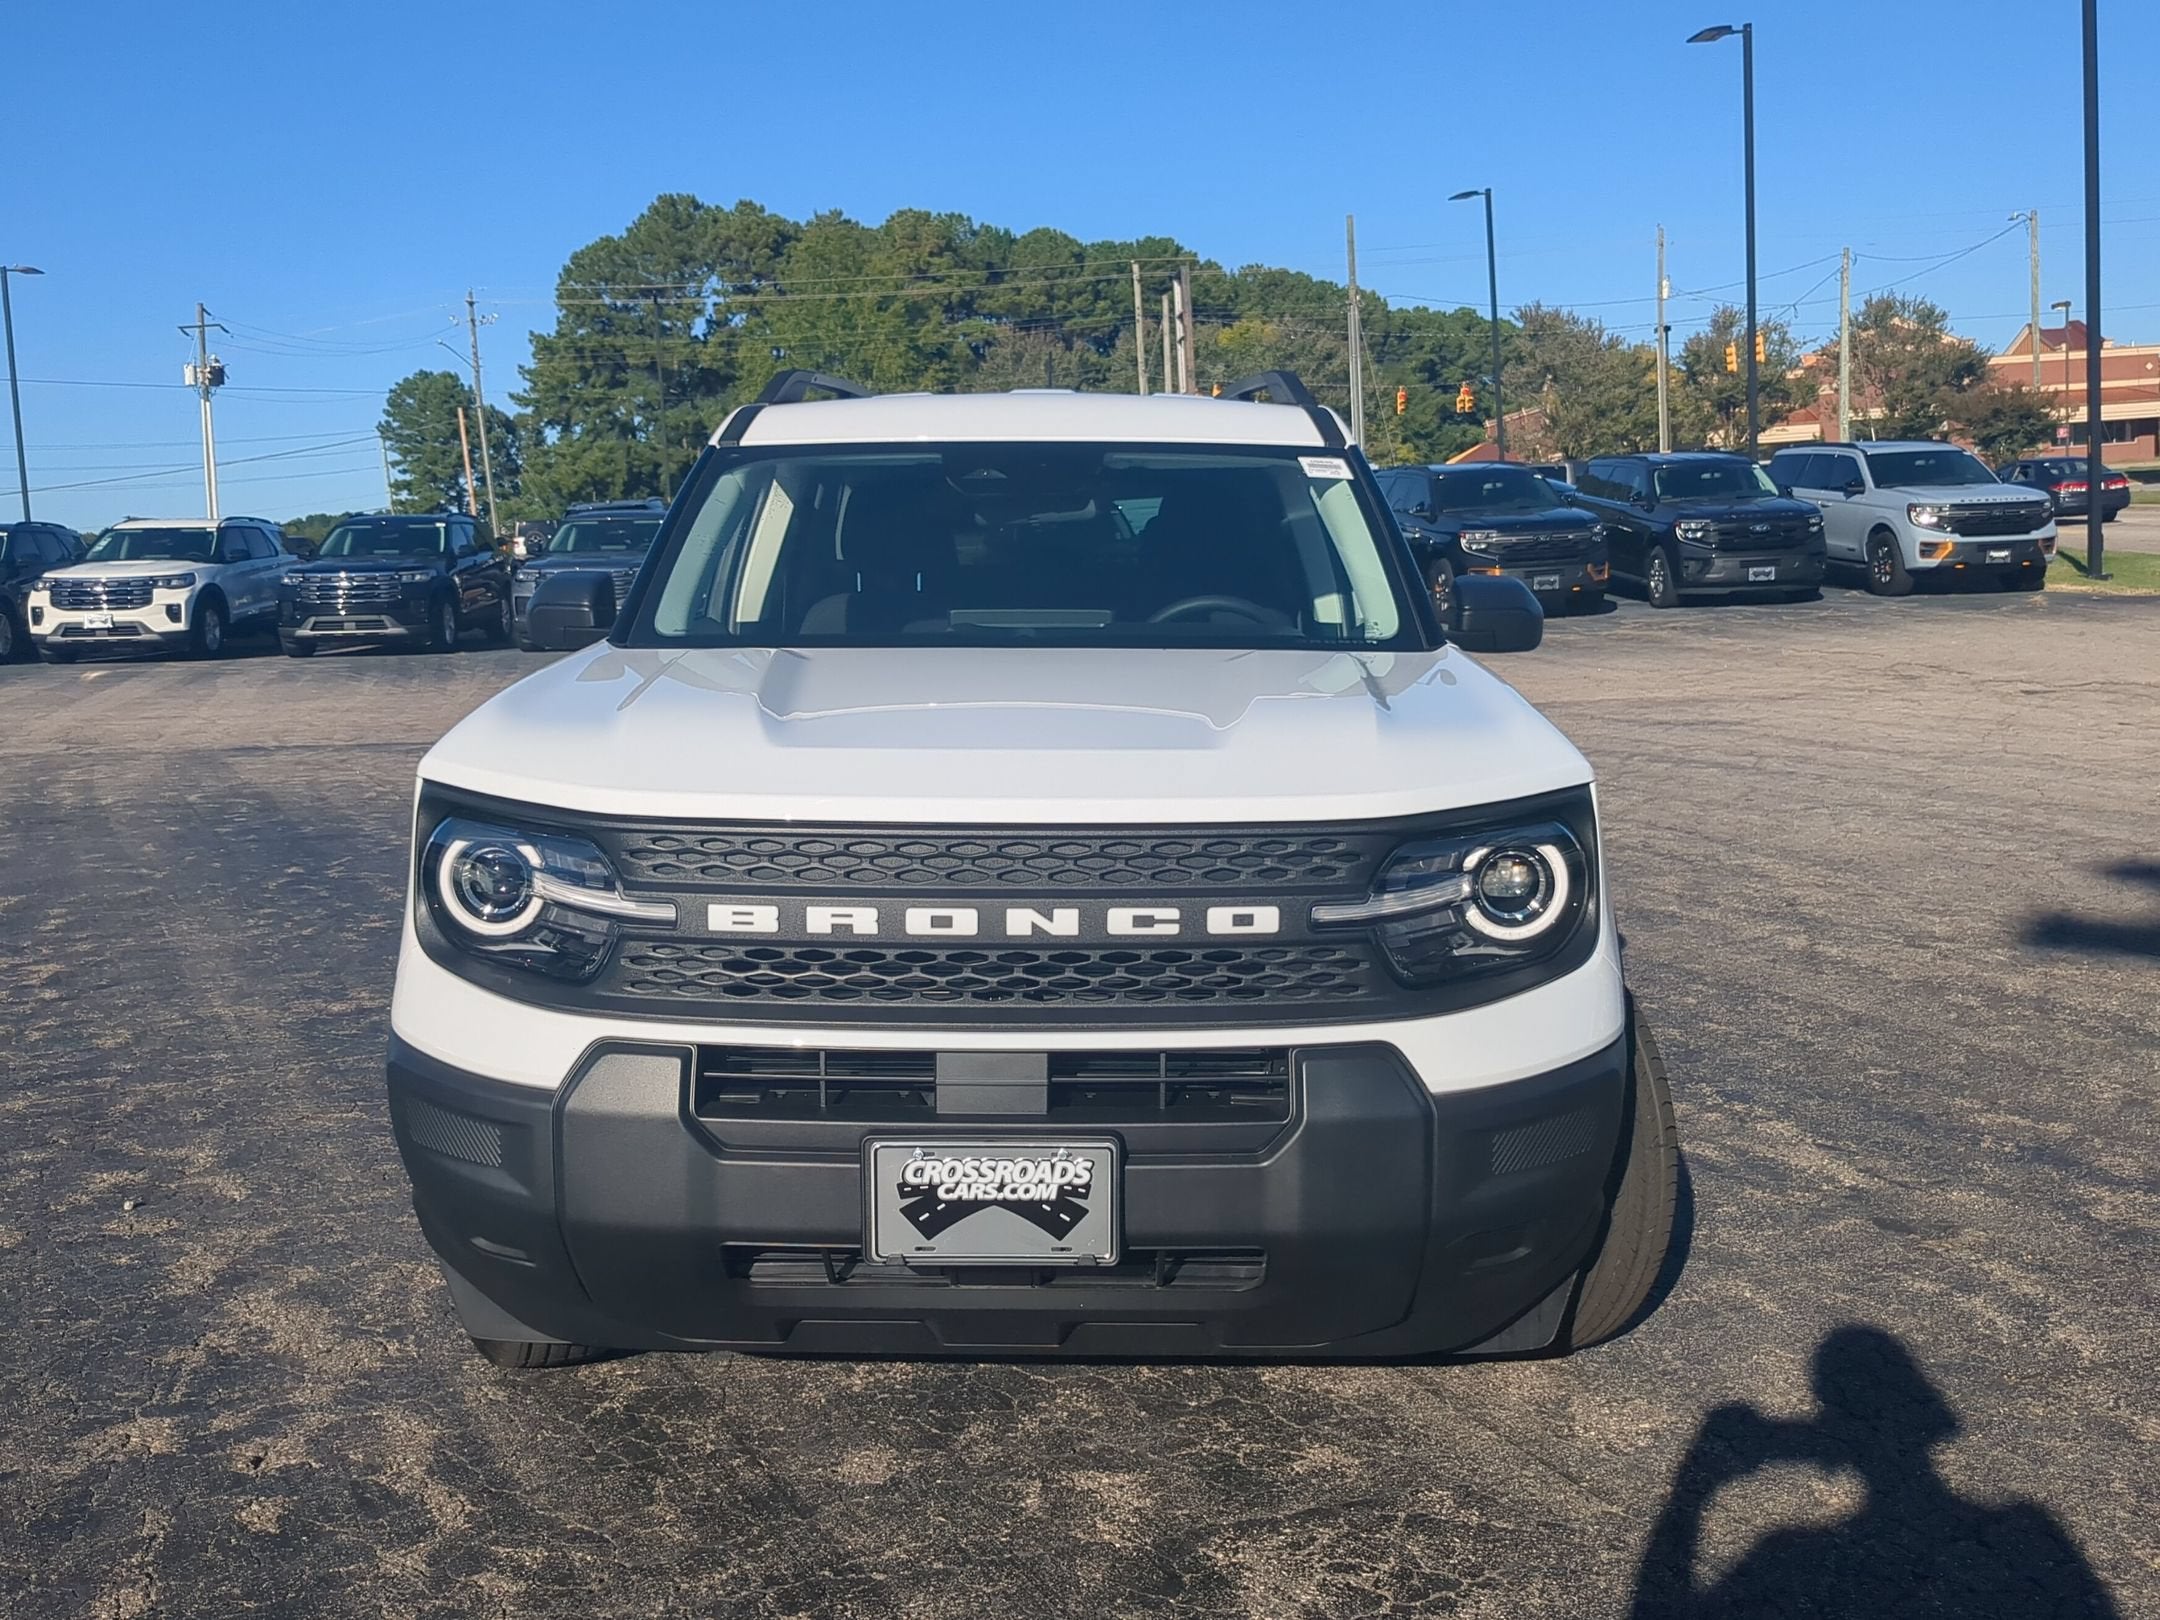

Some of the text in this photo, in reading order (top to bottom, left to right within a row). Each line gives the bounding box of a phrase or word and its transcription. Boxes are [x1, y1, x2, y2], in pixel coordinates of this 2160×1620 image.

[707, 905, 1280, 935] BRONCO
[903, 1159, 1093, 1185] CROSSROADS
[937, 1183, 1058, 1200] CARS.COM
